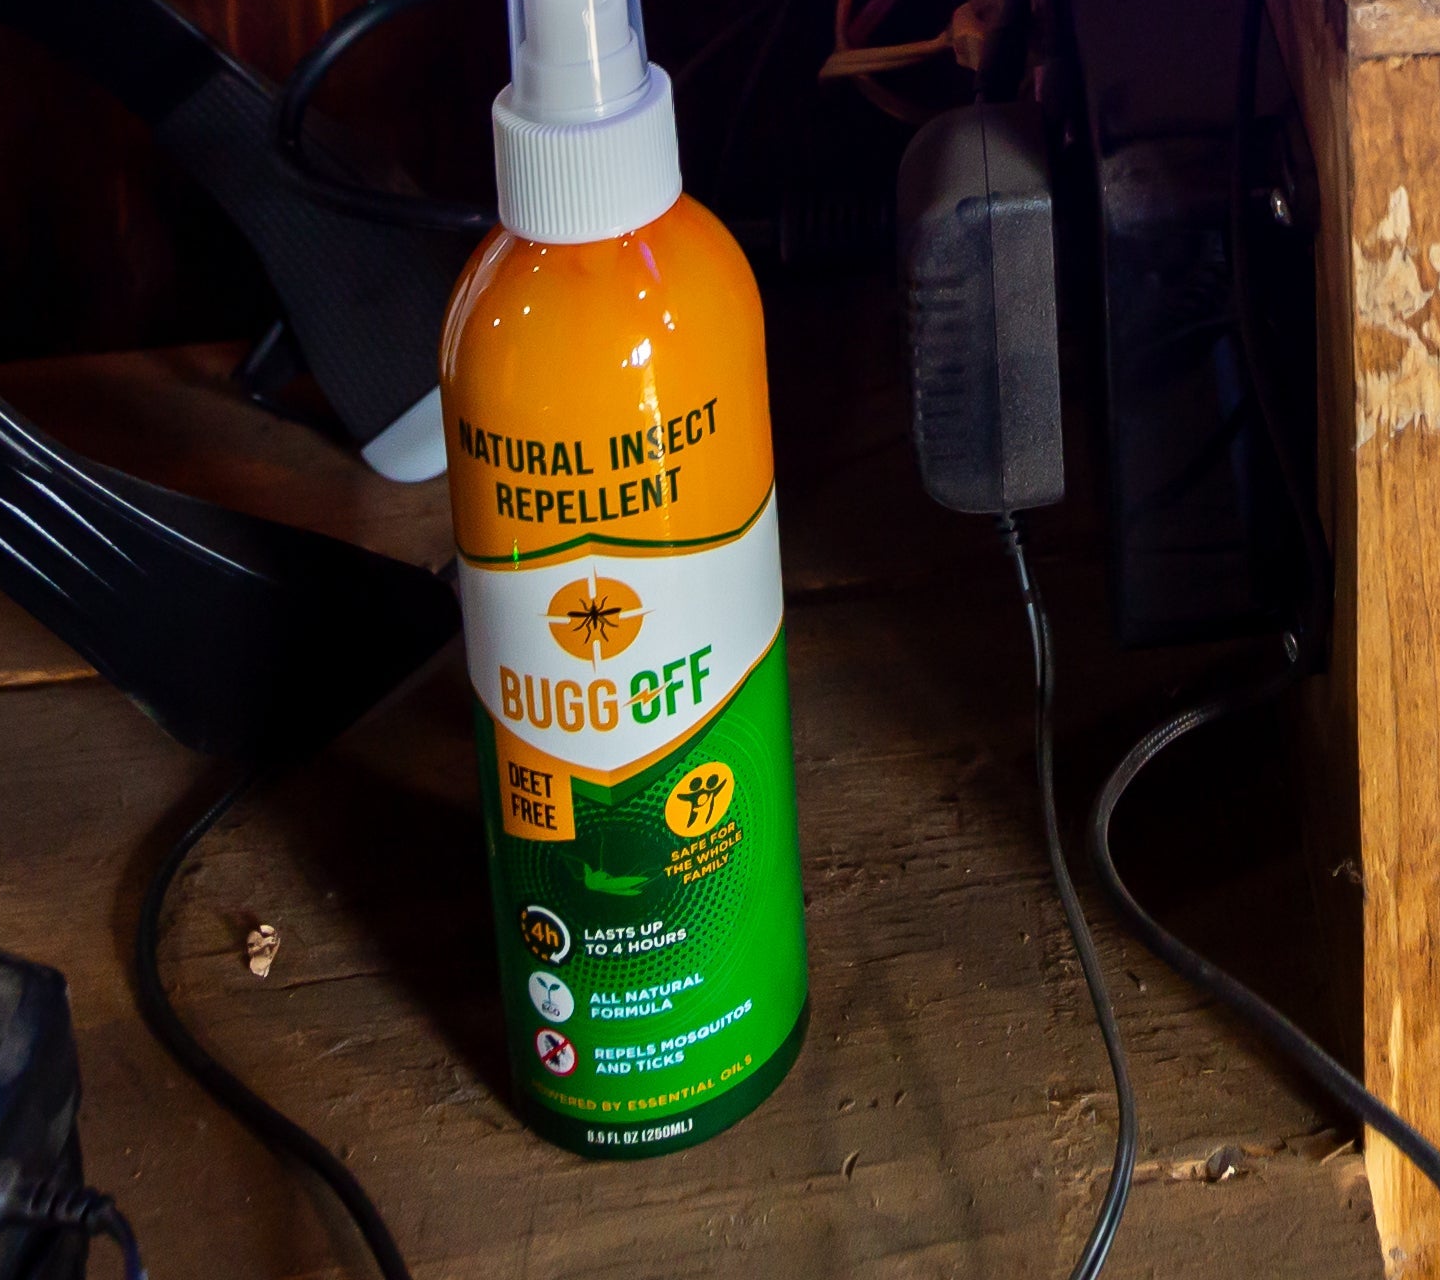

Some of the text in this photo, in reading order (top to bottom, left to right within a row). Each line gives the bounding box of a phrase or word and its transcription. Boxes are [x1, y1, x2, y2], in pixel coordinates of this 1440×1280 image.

[459, 397, 719, 477] NATURAL INSECT
[495, 466, 682, 525] REPELLENT
[499, 644, 713, 734] BUGG OFF
[508, 761, 554, 800] DEET
[511, 798, 558, 831] FREE
[664, 830, 744, 878] THE WHOLE
[670, 821, 738, 863] SAFE FOR
[682, 854, 730, 886] FAMILY
[530, 925, 560, 950] 4h
[584, 921, 665, 942] LASTS UP
[585, 928, 688, 956] TO 4 HOURS
[590, 972, 705, 1006] ALL NATURAL
[590, 999, 673, 1020] FORMULA
[594, 999, 754, 1061] REPELS MOSQUITOS
[595, 1051, 686, 1075] AND TICKS
[531, 1054, 754, 1113] POWERED BY ESSENTIAL OILS
[607, 1129, 622, 1145] FL
[623, 1128, 640, 1144] OZ
